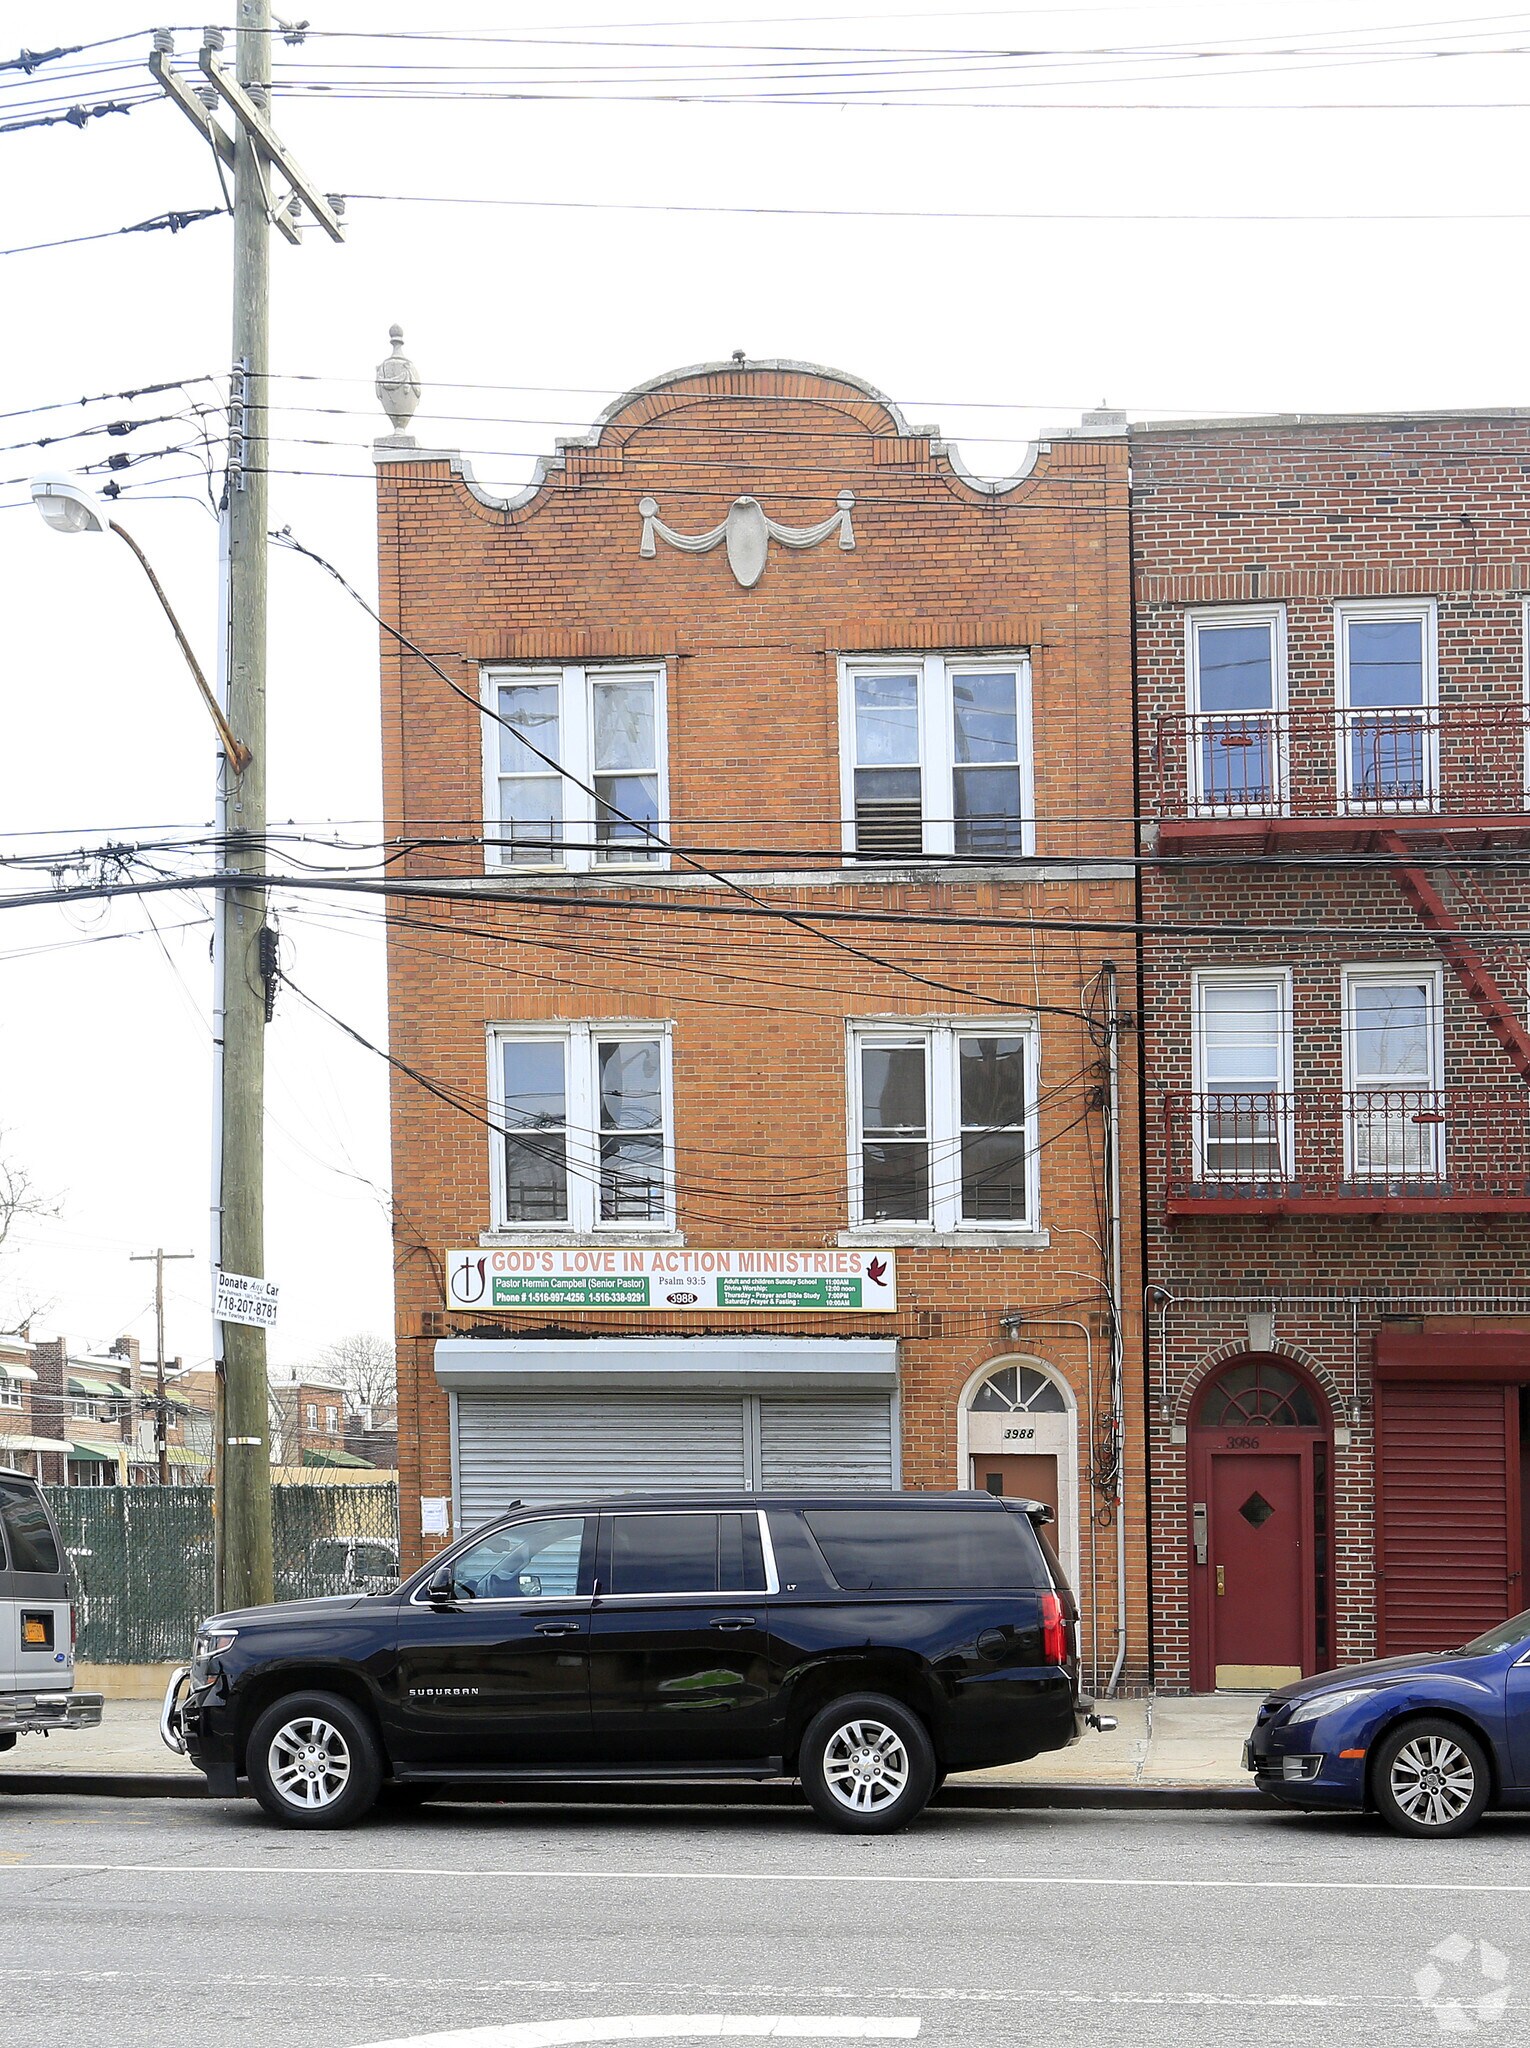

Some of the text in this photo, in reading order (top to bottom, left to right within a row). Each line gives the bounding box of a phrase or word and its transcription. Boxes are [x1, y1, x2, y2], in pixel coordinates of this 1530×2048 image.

[492, 1251, 862, 1273] GOD'S LOVE IN ACTION MINISTRIES
[219, 1274, 248, 1290] Donate
[266, 1283, 279, 1296] Car
[495, 1278, 645, 1290] Pastor Hermin Campbell (Senior Pastor)
[658, 1276, 707, 1286] Psalm 93:5
[496, 1292, 645, 1303] Phone # 1-516-997-4256 1-516-338-9291
[670, 1292, 695, 1304] 3988
[724, 1292, 752, 1300] Thursday
[755, 1292, 775, 1300] Prayer
[216, 1309, 227, 1317] Free
[228, 1311, 244, 1321] Towing
[1004, 1429, 1034, 1439] 3988
[1226, 1436, 1260, 1449] 3986
[408, 1687, 479, 1696] SUBURBAN
